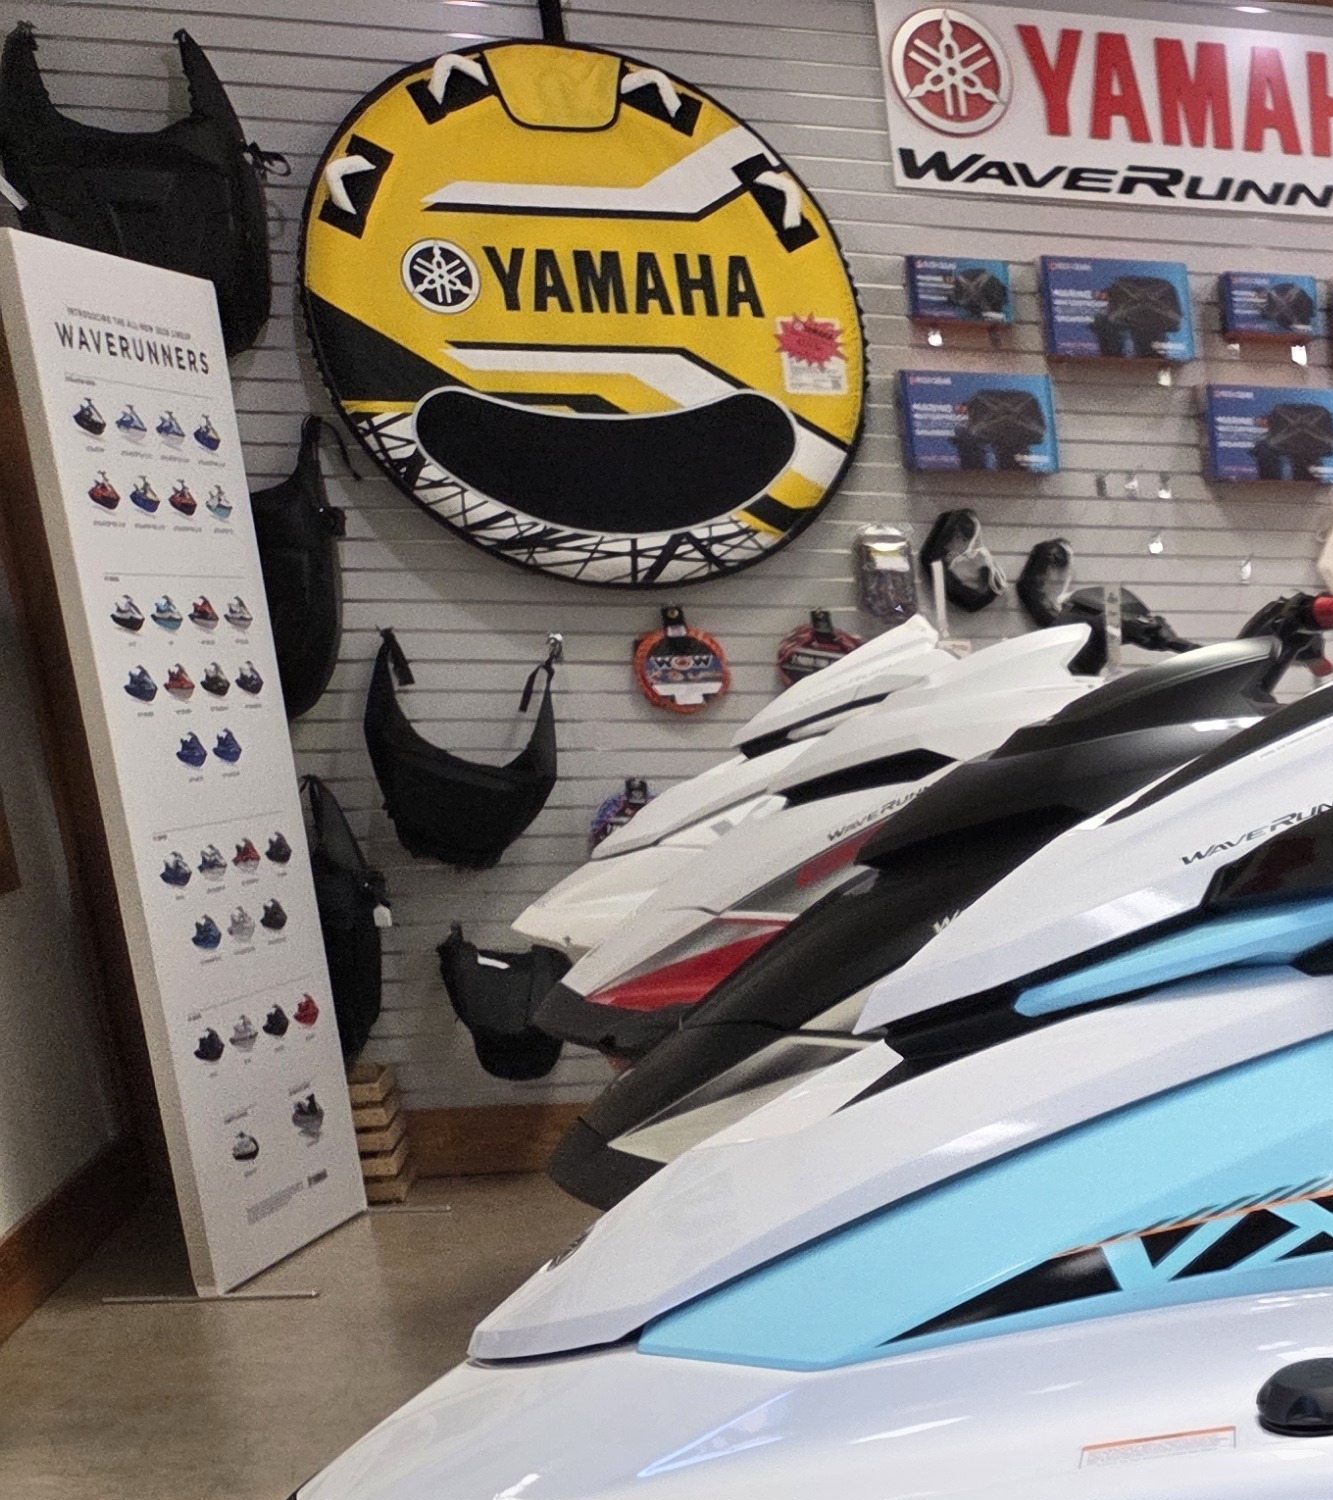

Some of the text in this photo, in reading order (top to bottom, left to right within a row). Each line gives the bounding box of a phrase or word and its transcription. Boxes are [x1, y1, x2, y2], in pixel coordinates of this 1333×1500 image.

[482, 246, 765, 318] YAMAHA
[55, 321, 210, 375] WAVERUNNERS
[649, 654, 713, 670] WOW
